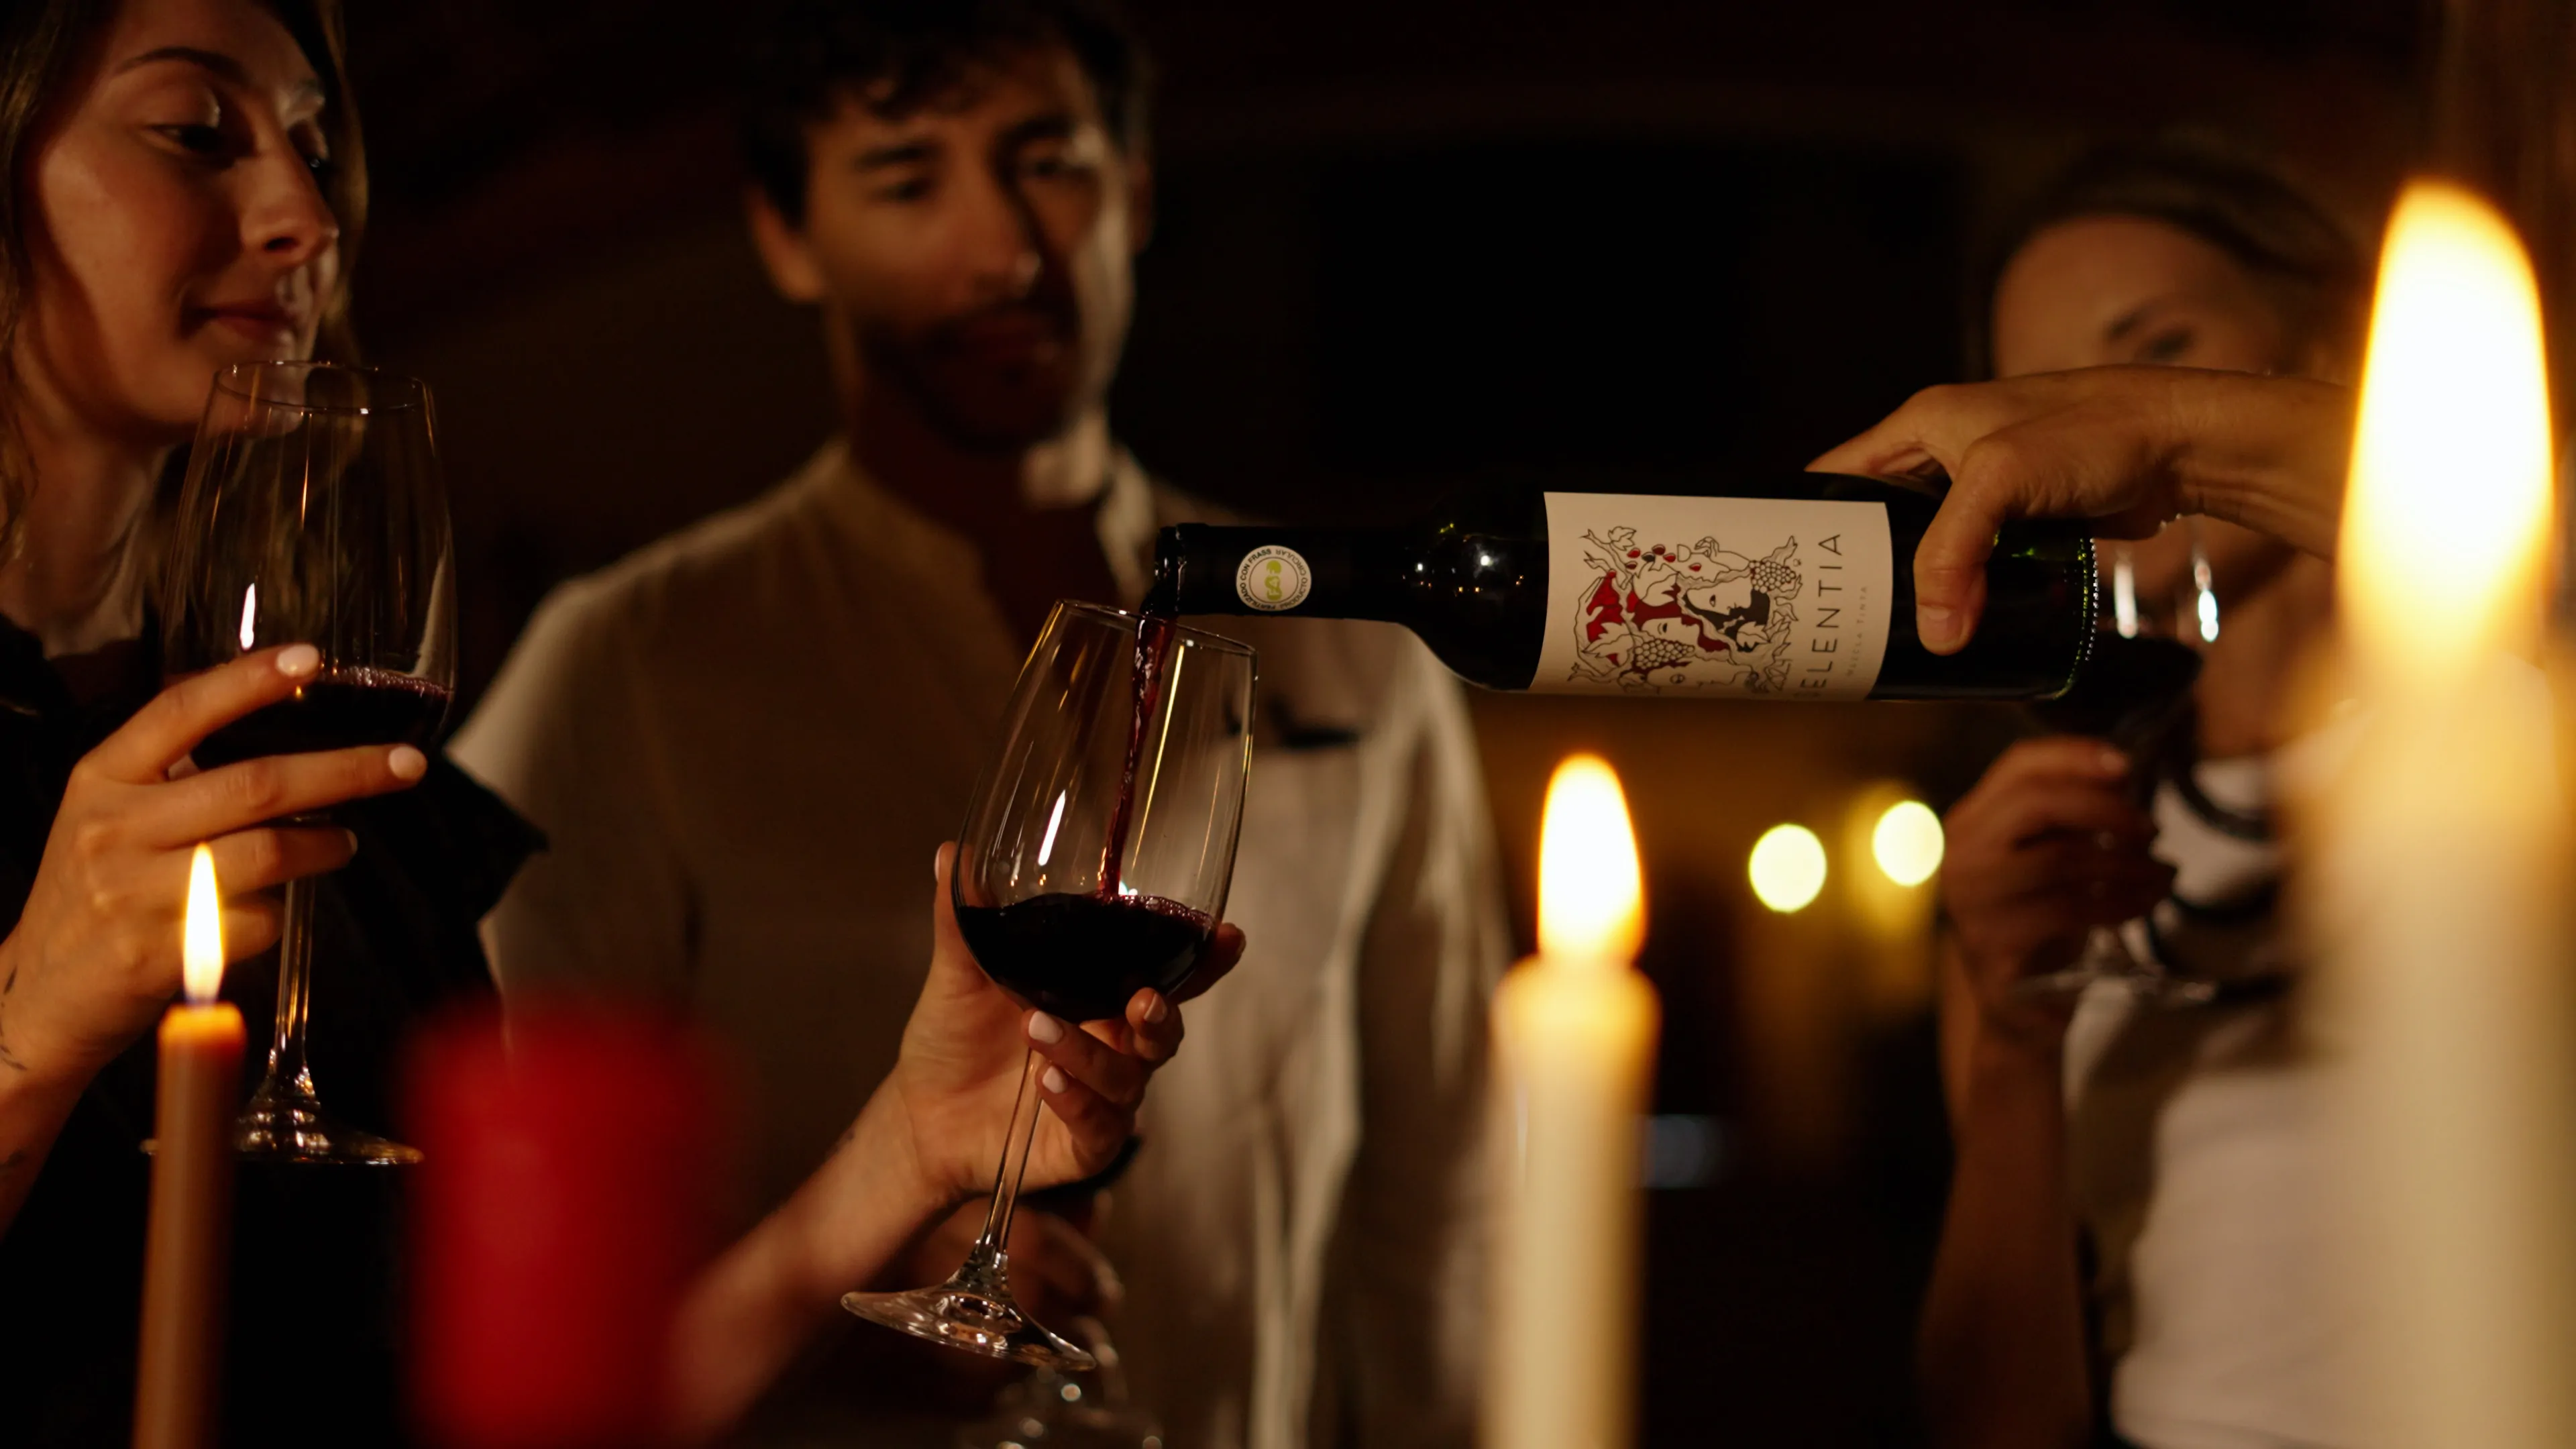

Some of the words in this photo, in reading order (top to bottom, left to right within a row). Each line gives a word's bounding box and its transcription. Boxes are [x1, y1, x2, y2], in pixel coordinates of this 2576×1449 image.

[1240, 563, 1250, 581] CON
[1248, 548, 1272, 564] FRASS
[1275, 549, 1307, 576] CIRCULAR
[1279, 577, 1308, 609] PRODUCTO
[1792, 534, 1842, 696] ELENTIA
